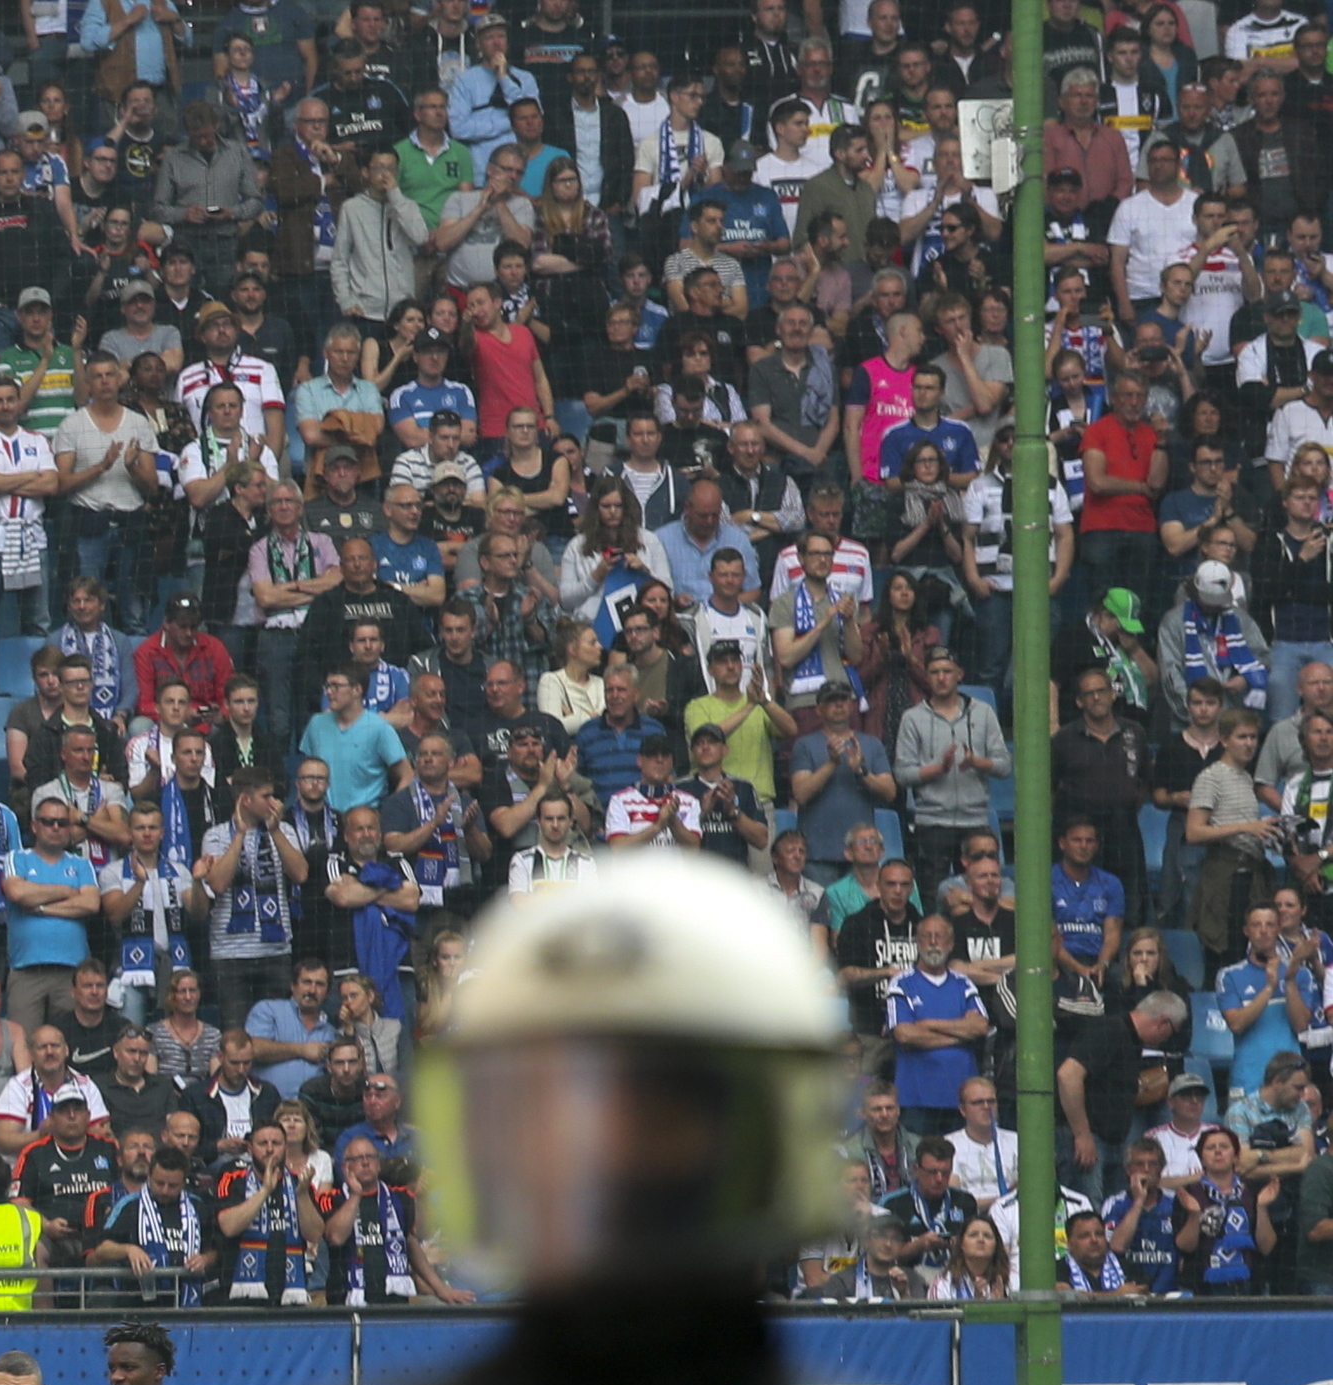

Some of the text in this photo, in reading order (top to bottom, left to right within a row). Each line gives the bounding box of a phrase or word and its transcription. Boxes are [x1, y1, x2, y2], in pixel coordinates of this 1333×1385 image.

[352, 112, 365, 125] Fly
[336, 120, 382, 136] Emirates
[876, 402, 915, 417] Emirat
[70, 1171, 89, 1185] Fly
